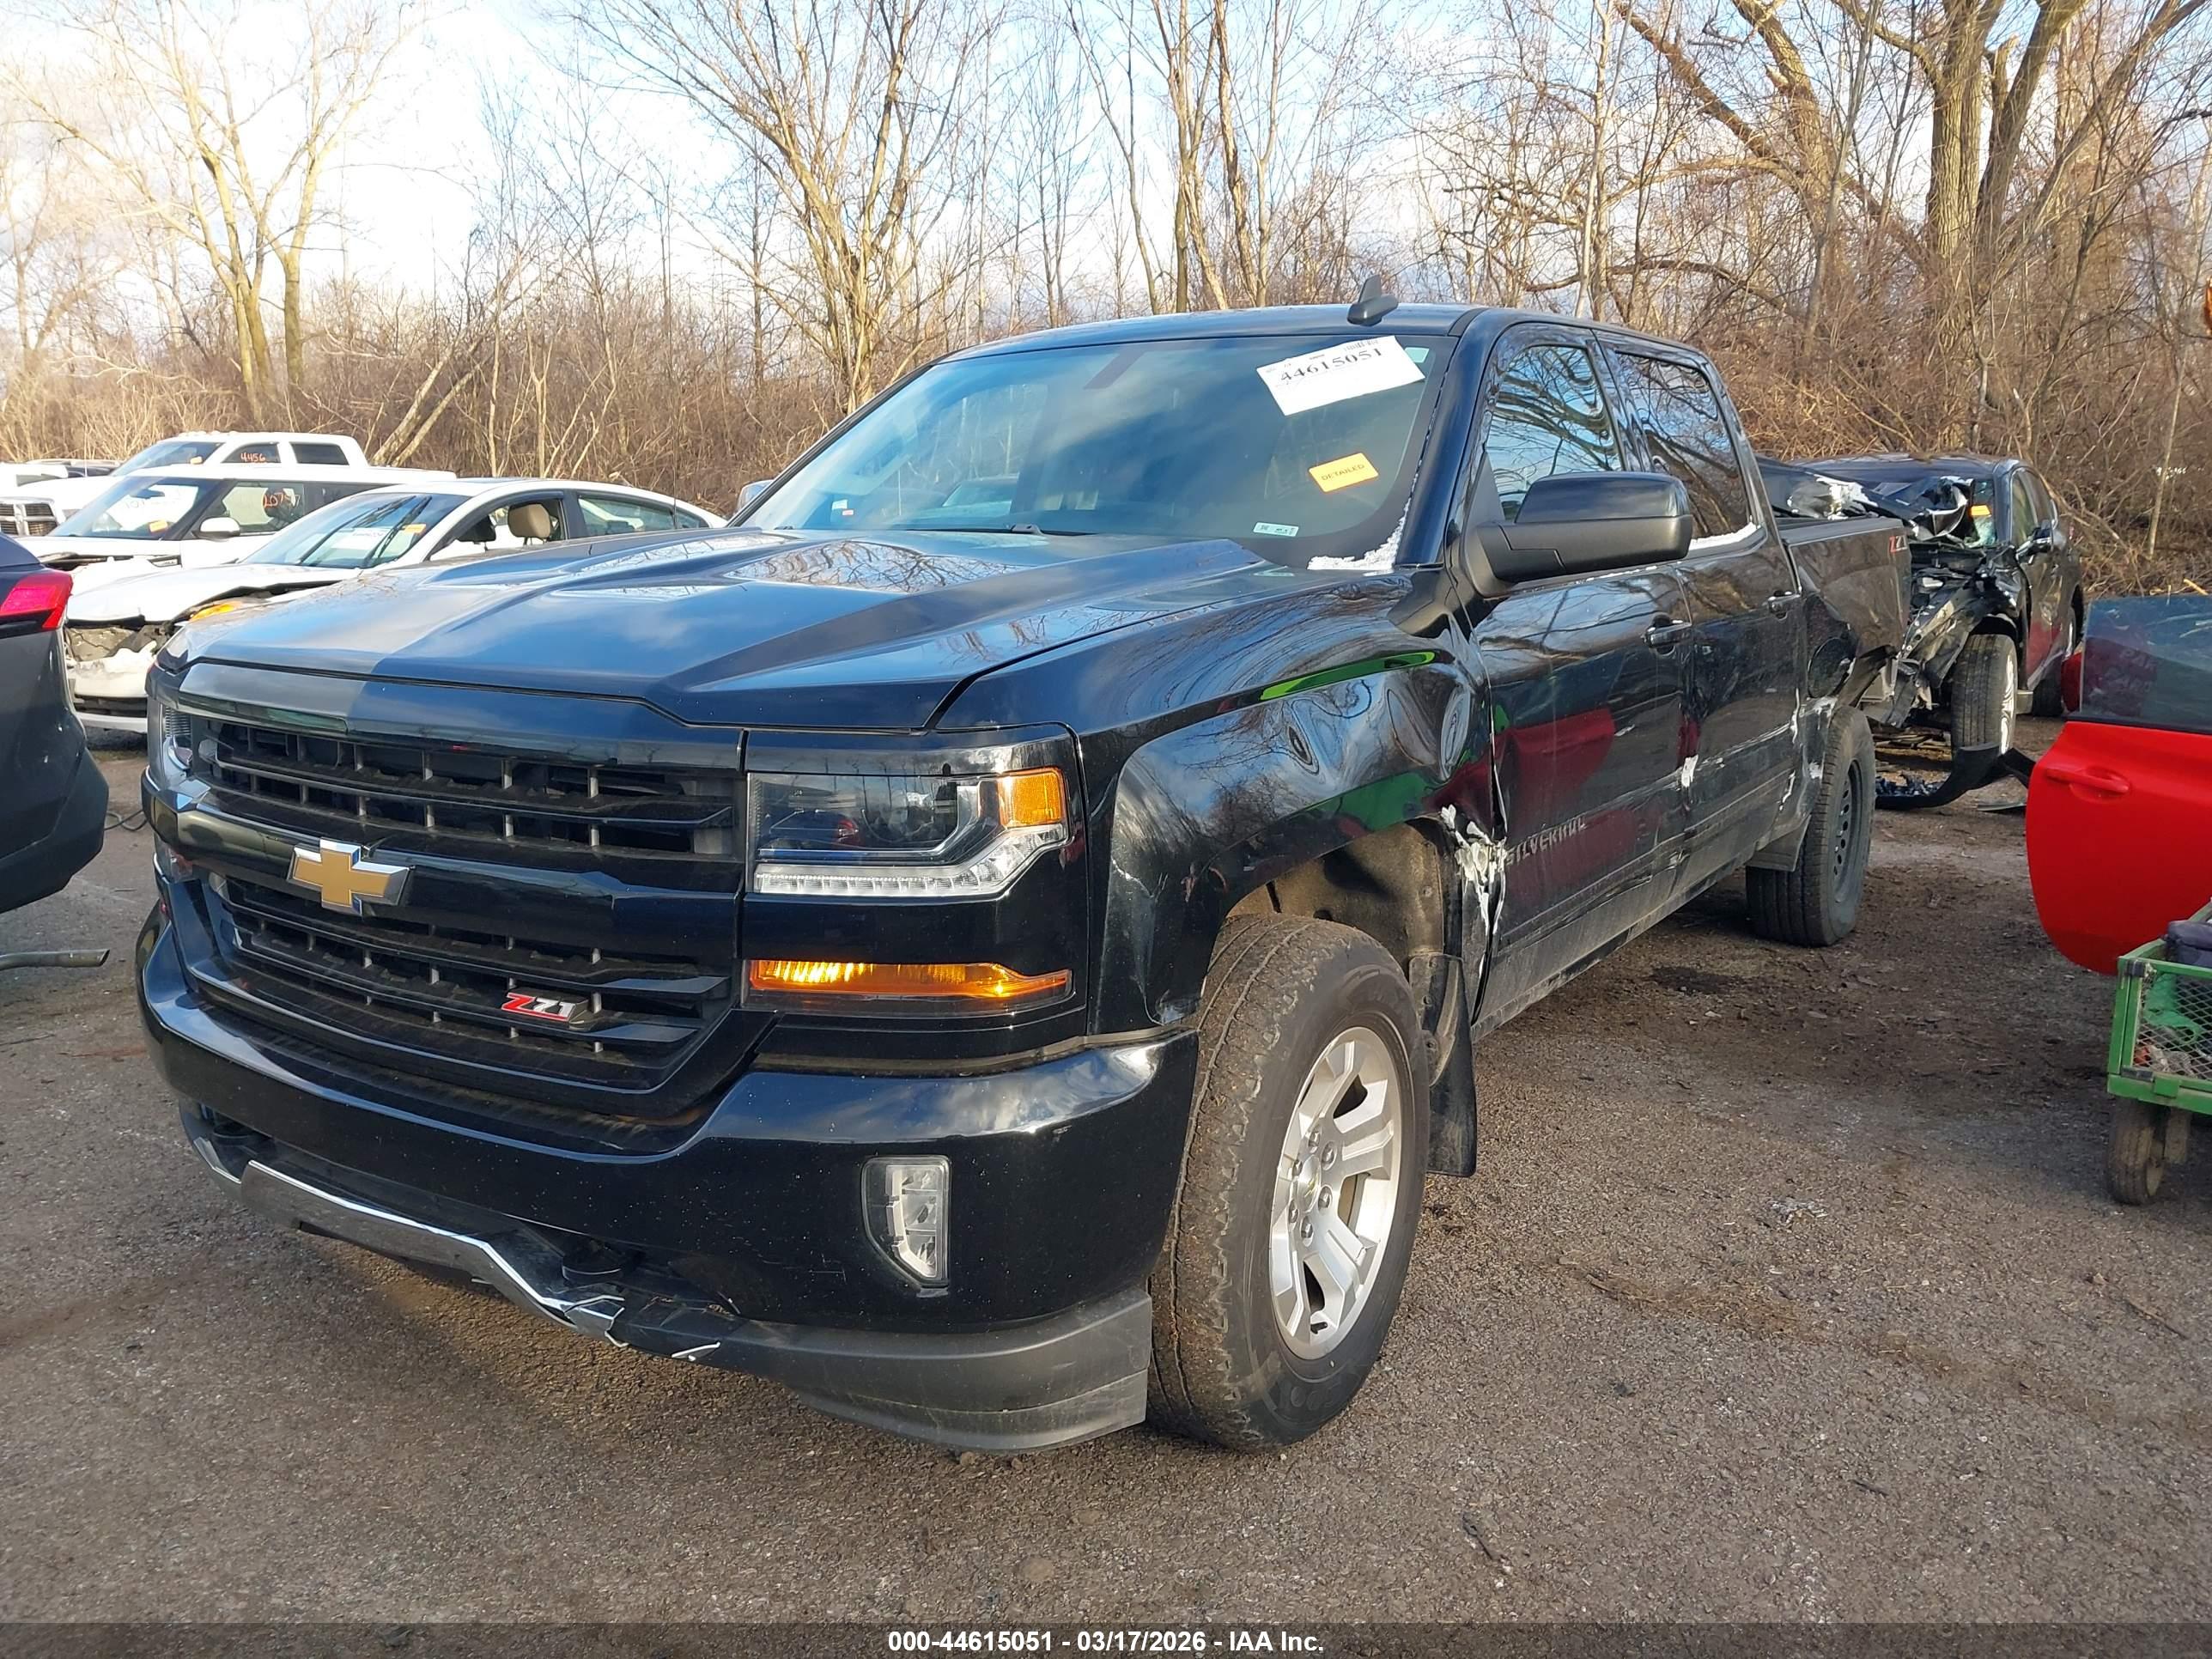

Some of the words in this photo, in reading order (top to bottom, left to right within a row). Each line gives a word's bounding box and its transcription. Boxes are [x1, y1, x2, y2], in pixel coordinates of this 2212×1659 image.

[1279, 347, 1382, 382] 44615051
[1321, 463, 1365, 481] DETAILED
[501, 992, 576, 1023] Z71
